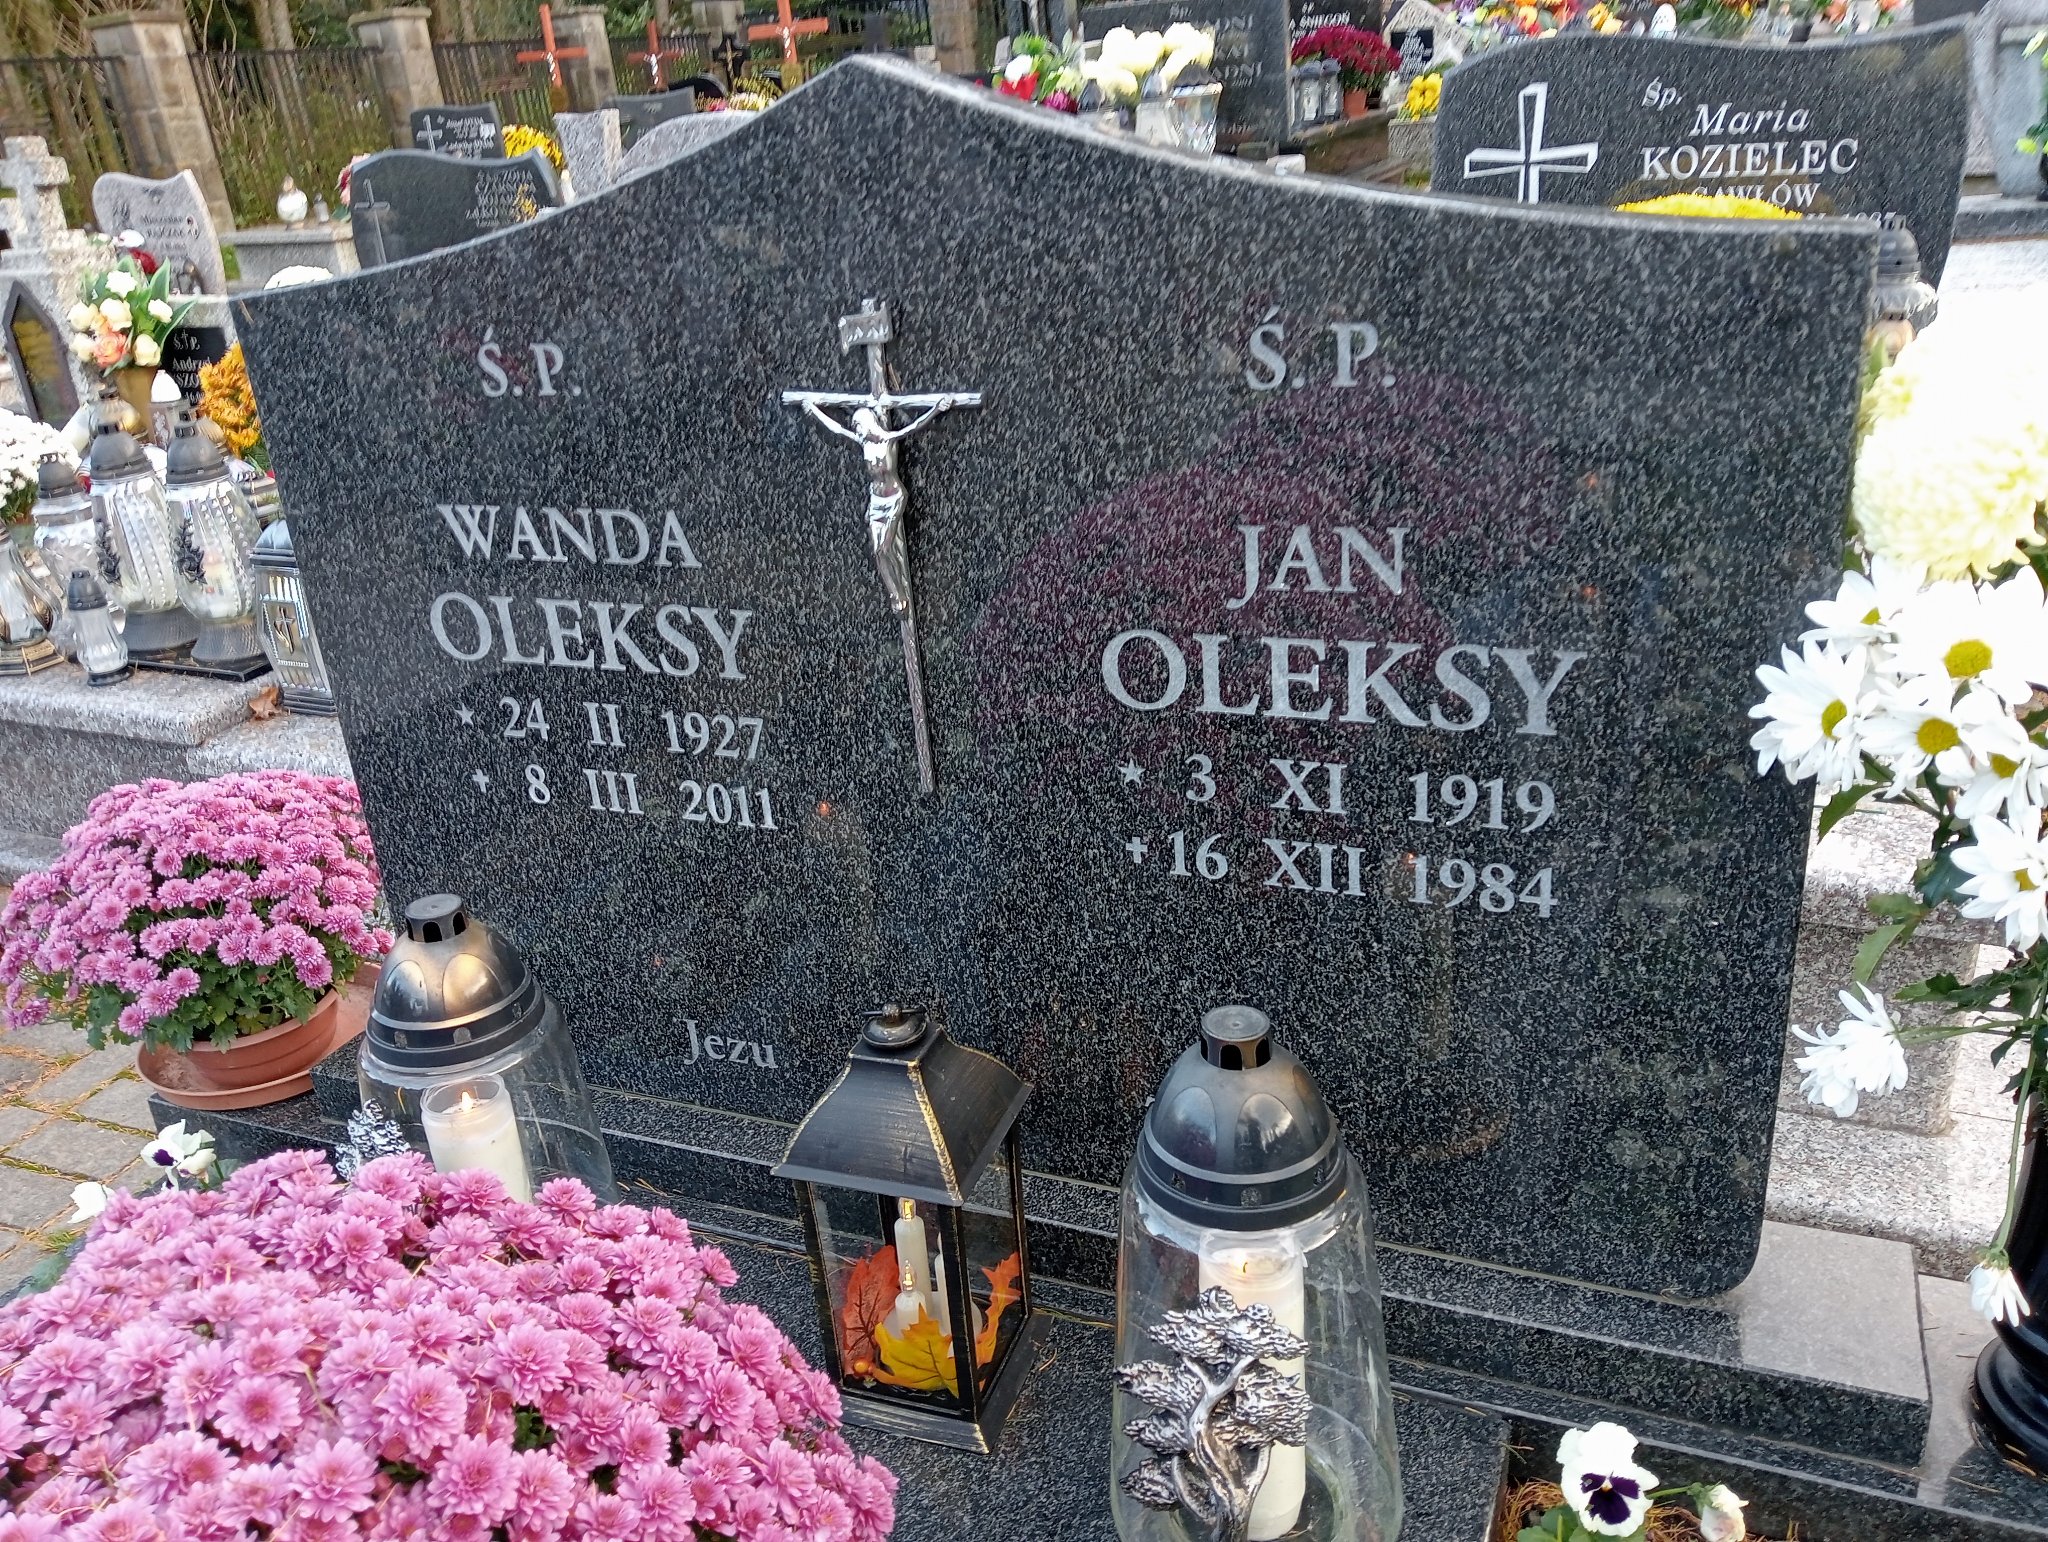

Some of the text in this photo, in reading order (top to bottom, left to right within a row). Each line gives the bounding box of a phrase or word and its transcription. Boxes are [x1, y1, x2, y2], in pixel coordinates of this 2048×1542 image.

[1689, 100, 1811, 137] Maria
[1640, 138, 1859, 181] KOZIELEC
[437, 504, 702, 569] WANDA
[1226, 524, 1410, 611] JAN
[430, 591, 753, 680] OLEKSY
[1101, 629, 1588, 737] OLEKSY
[500, 697, 764, 760] 24 II 1927
[525, 764, 779, 830] 8 III 2011
[1184, 754, 1556, 834] 3 XI 1919
[1168, 830, 1559, 918] 16 XII 1984
[679, 1018, 779, 1069] Jezu
